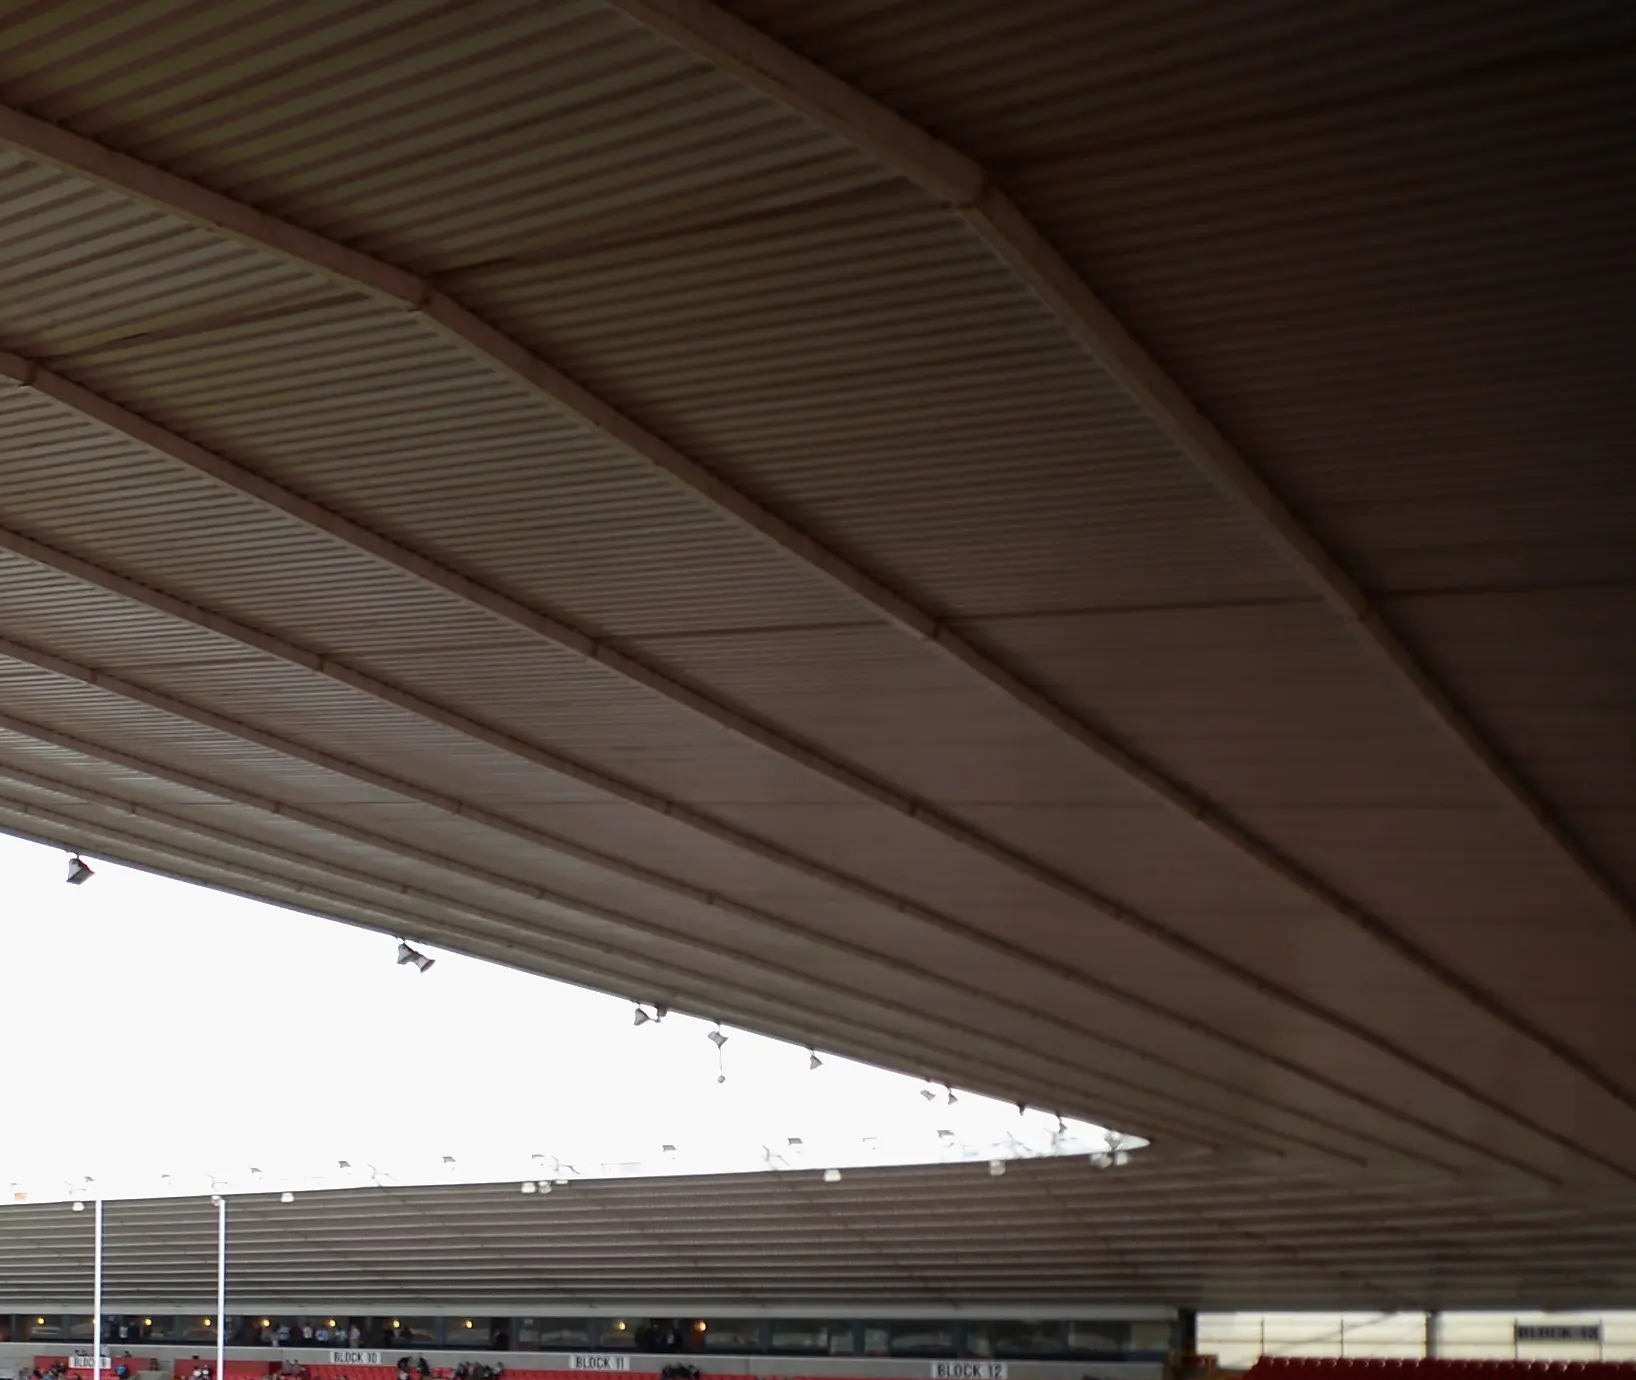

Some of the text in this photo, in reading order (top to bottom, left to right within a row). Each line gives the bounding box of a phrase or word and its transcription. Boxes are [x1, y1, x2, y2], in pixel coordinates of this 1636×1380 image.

[333, 1351, 362, 1364] BLOCK
[575, 1356, 612, 1368] BLOCK
[937, 1362, 1003, 1379] BLOCK 12
